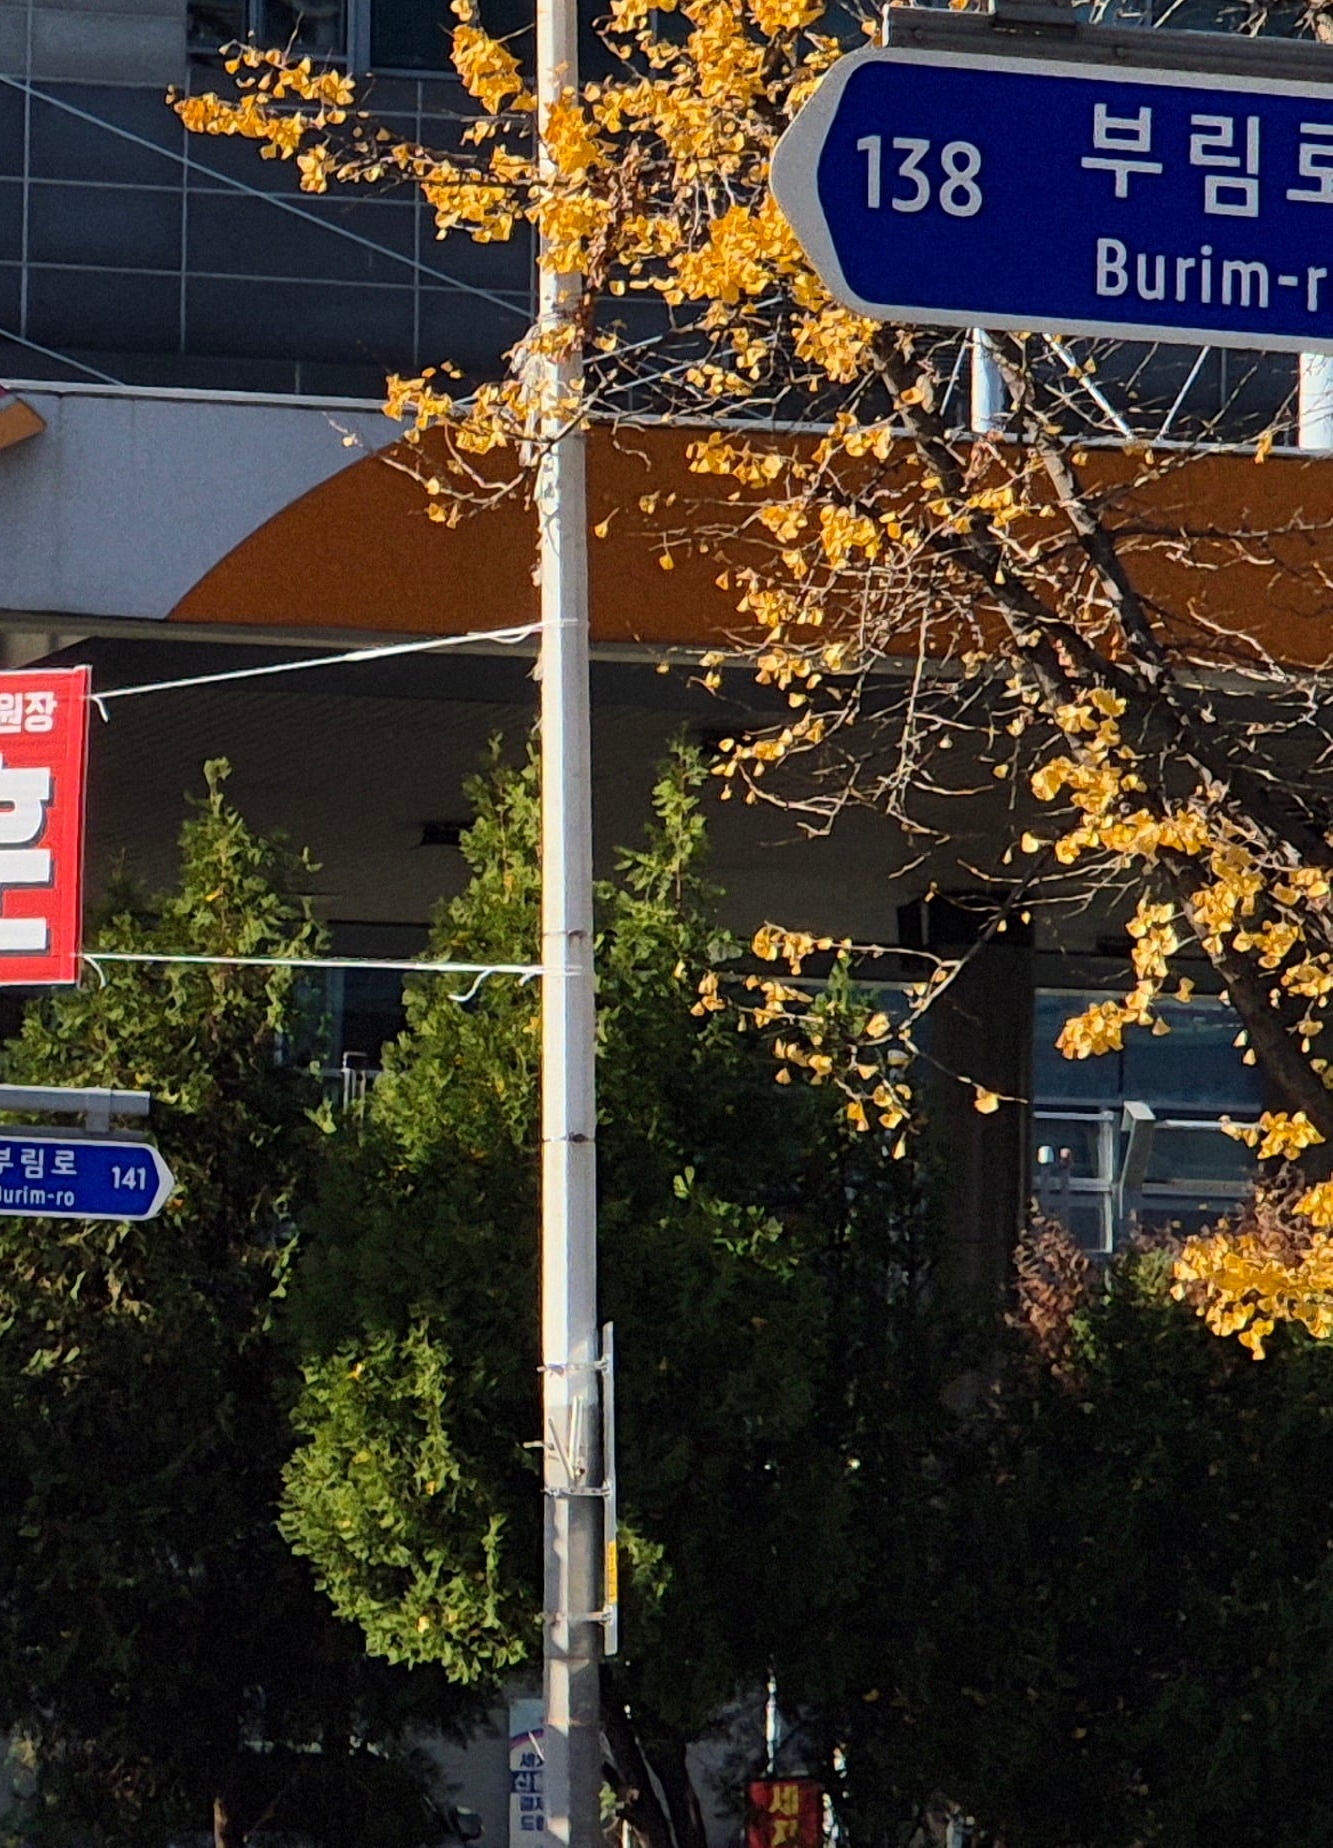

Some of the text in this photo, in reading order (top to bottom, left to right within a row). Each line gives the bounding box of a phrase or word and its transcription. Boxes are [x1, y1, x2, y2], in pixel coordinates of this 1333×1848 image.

[856, 134, 983, 218] 138
[1081, 103, 1333, 217] 부림로
[1097, 238, 1328, 312] Burim-r
[112, 1167, 147, 1191] 141
